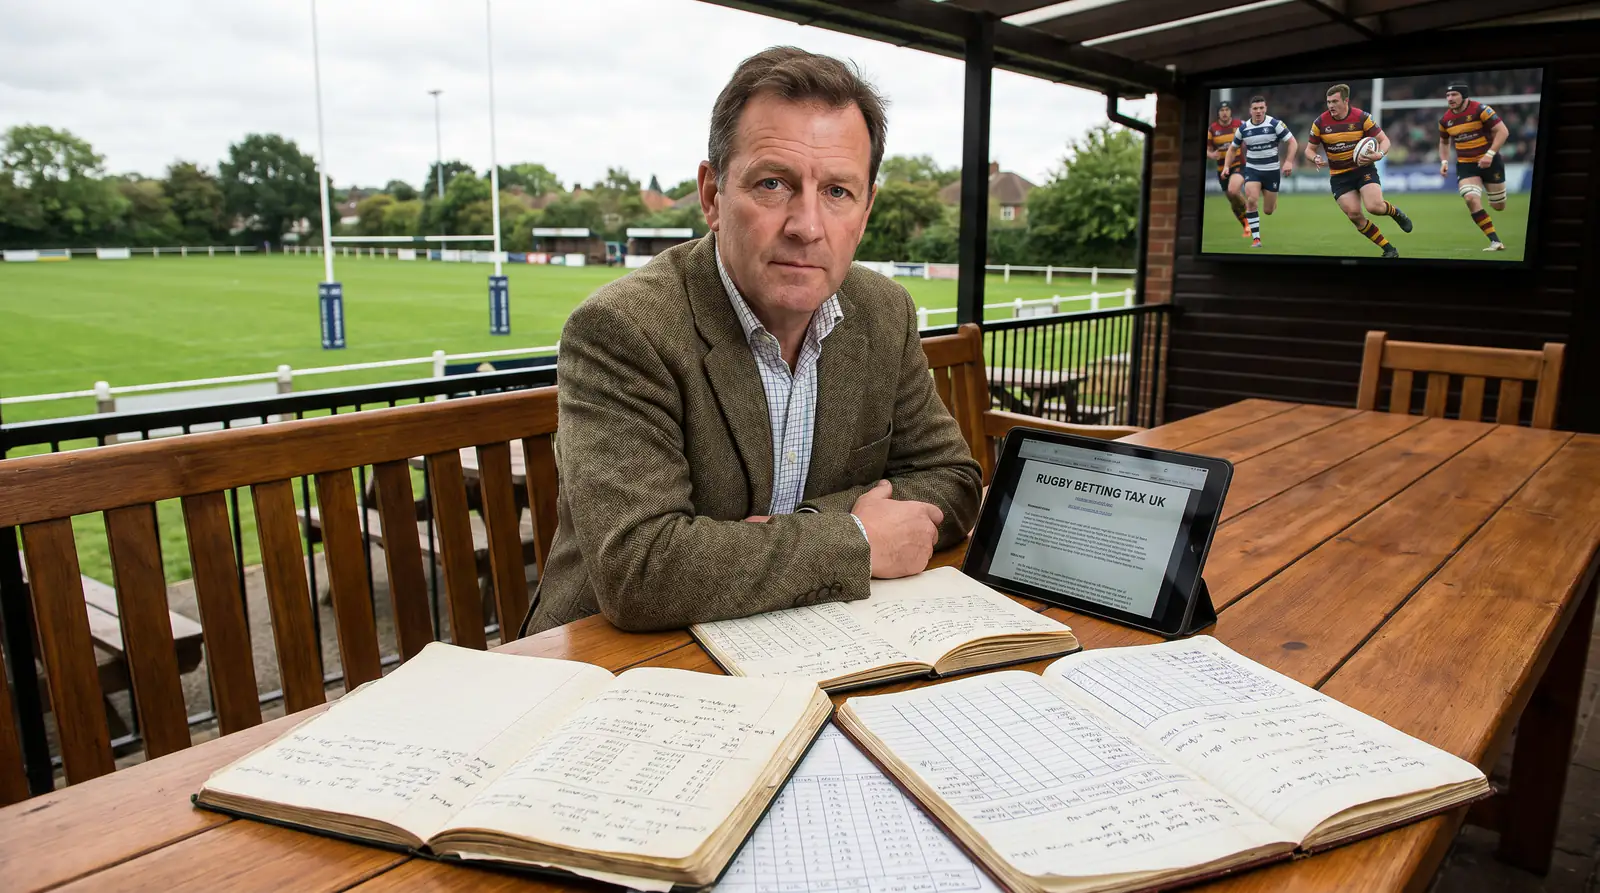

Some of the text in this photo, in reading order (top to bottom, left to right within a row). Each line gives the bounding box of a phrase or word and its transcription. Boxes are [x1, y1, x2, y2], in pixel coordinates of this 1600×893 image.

[1036, 473, 1073, 489] RUGBY
[1074, 481, 1122, 498] BETTING
[1124, 490, 1146, 503] TAX
[1149, 495, 1166, 508] UK
